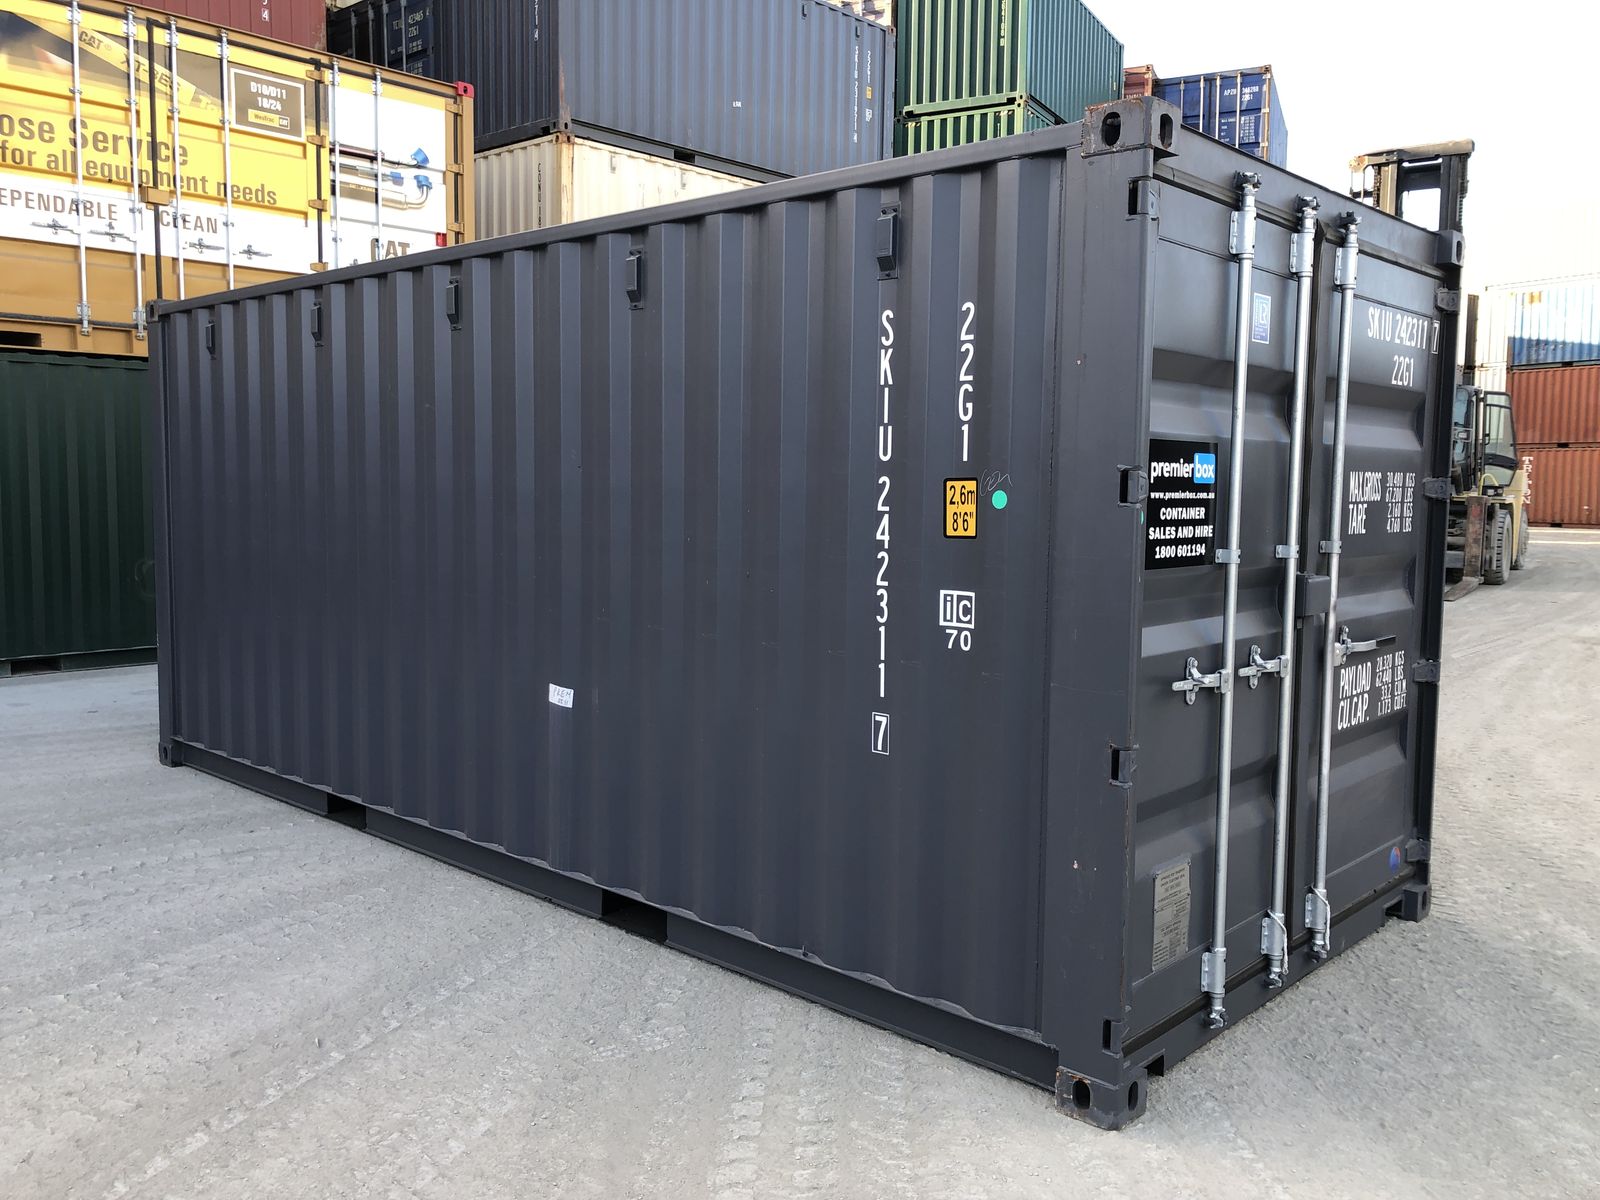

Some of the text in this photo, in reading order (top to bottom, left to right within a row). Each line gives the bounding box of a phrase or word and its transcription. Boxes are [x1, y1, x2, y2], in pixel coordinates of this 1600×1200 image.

[79, 30, 104, 51] CAT
[69, 117, 189, 166] Service
[0, 140, 37, 167] for
[216, 181, 277, 206] needs
[159, 210, 218, 234] CLEAN
[1368, 306, 1393, 342] SKIU
[1395, 313, 1428, 350] 242311
[958, 301, 976, 462] 22G1
[1391, 354, 1414, 387] 22G1
[1405, 473, 1416, 487] KGS
[949, 485, 976, 508] 2,6m
[1150, 490, 1215, 500] www.premierbox.com.au
[1404, 488, 1414, 502] LBS
[952, 511, 974, 532] 8'6"
[1160, 507, 1205, 520] CONTAINER
[1348, 503, 1367, 534] TARE
[1403, 503, 1413, 517] KGS
[875, 309, 894, 751] SKIU 242311 7
[1149, 525, 1213, 540] SALES AND HIRE
[1402, 518, 1412, 532] LBS
[1155, 543, 1205, 558] 1800 601194
[945, 629, 972, 651] 70
[1340, 661, 1372, 699] PAYLOAD
[1394, 650, 1405, 666] KGS
[1394, 665, 1404, 681] LBS
